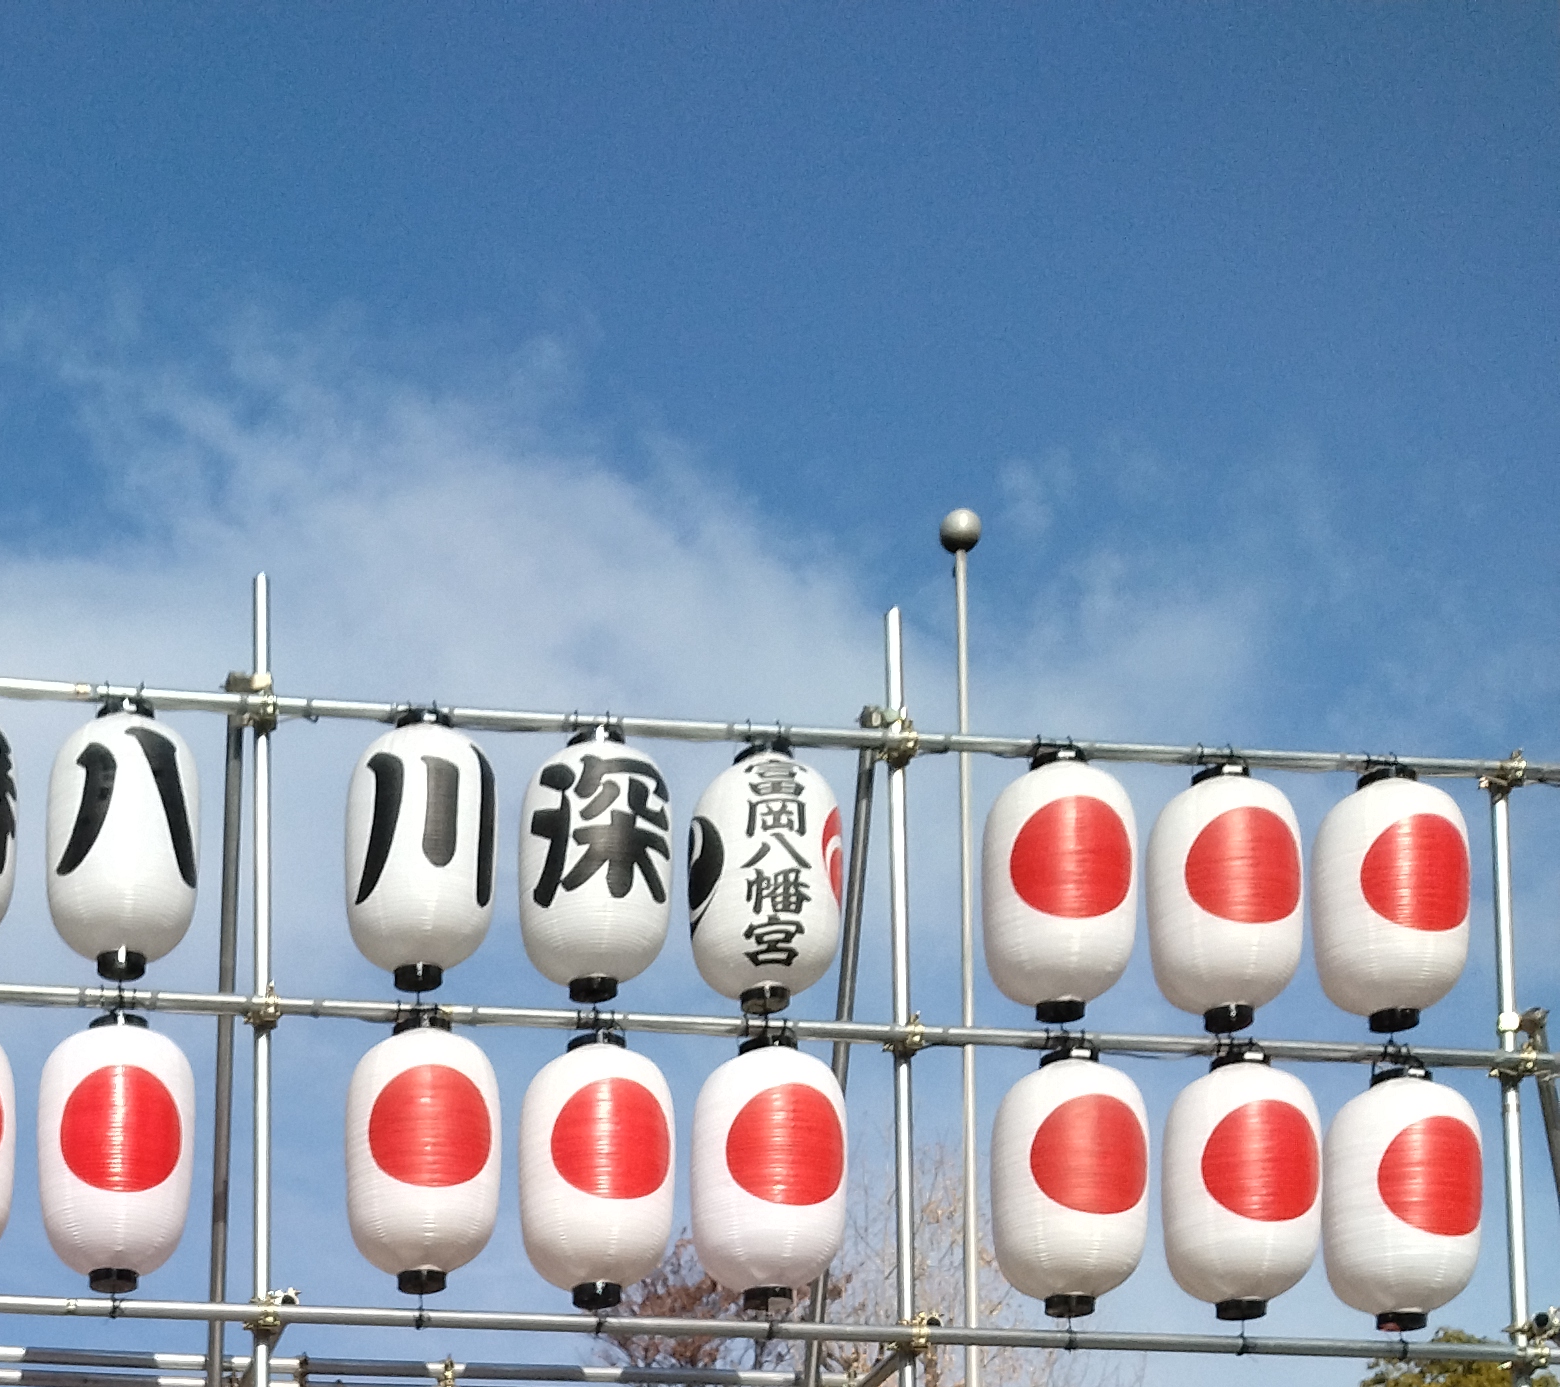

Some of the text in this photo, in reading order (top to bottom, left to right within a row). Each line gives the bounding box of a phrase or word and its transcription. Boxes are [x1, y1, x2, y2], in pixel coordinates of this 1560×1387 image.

[56, 726, 198, 889] 八
[355, 744, 496, 908] 川
[531, 754, 671, 908] 深
[740, 759, 812, 967] 富岡八幡宮
